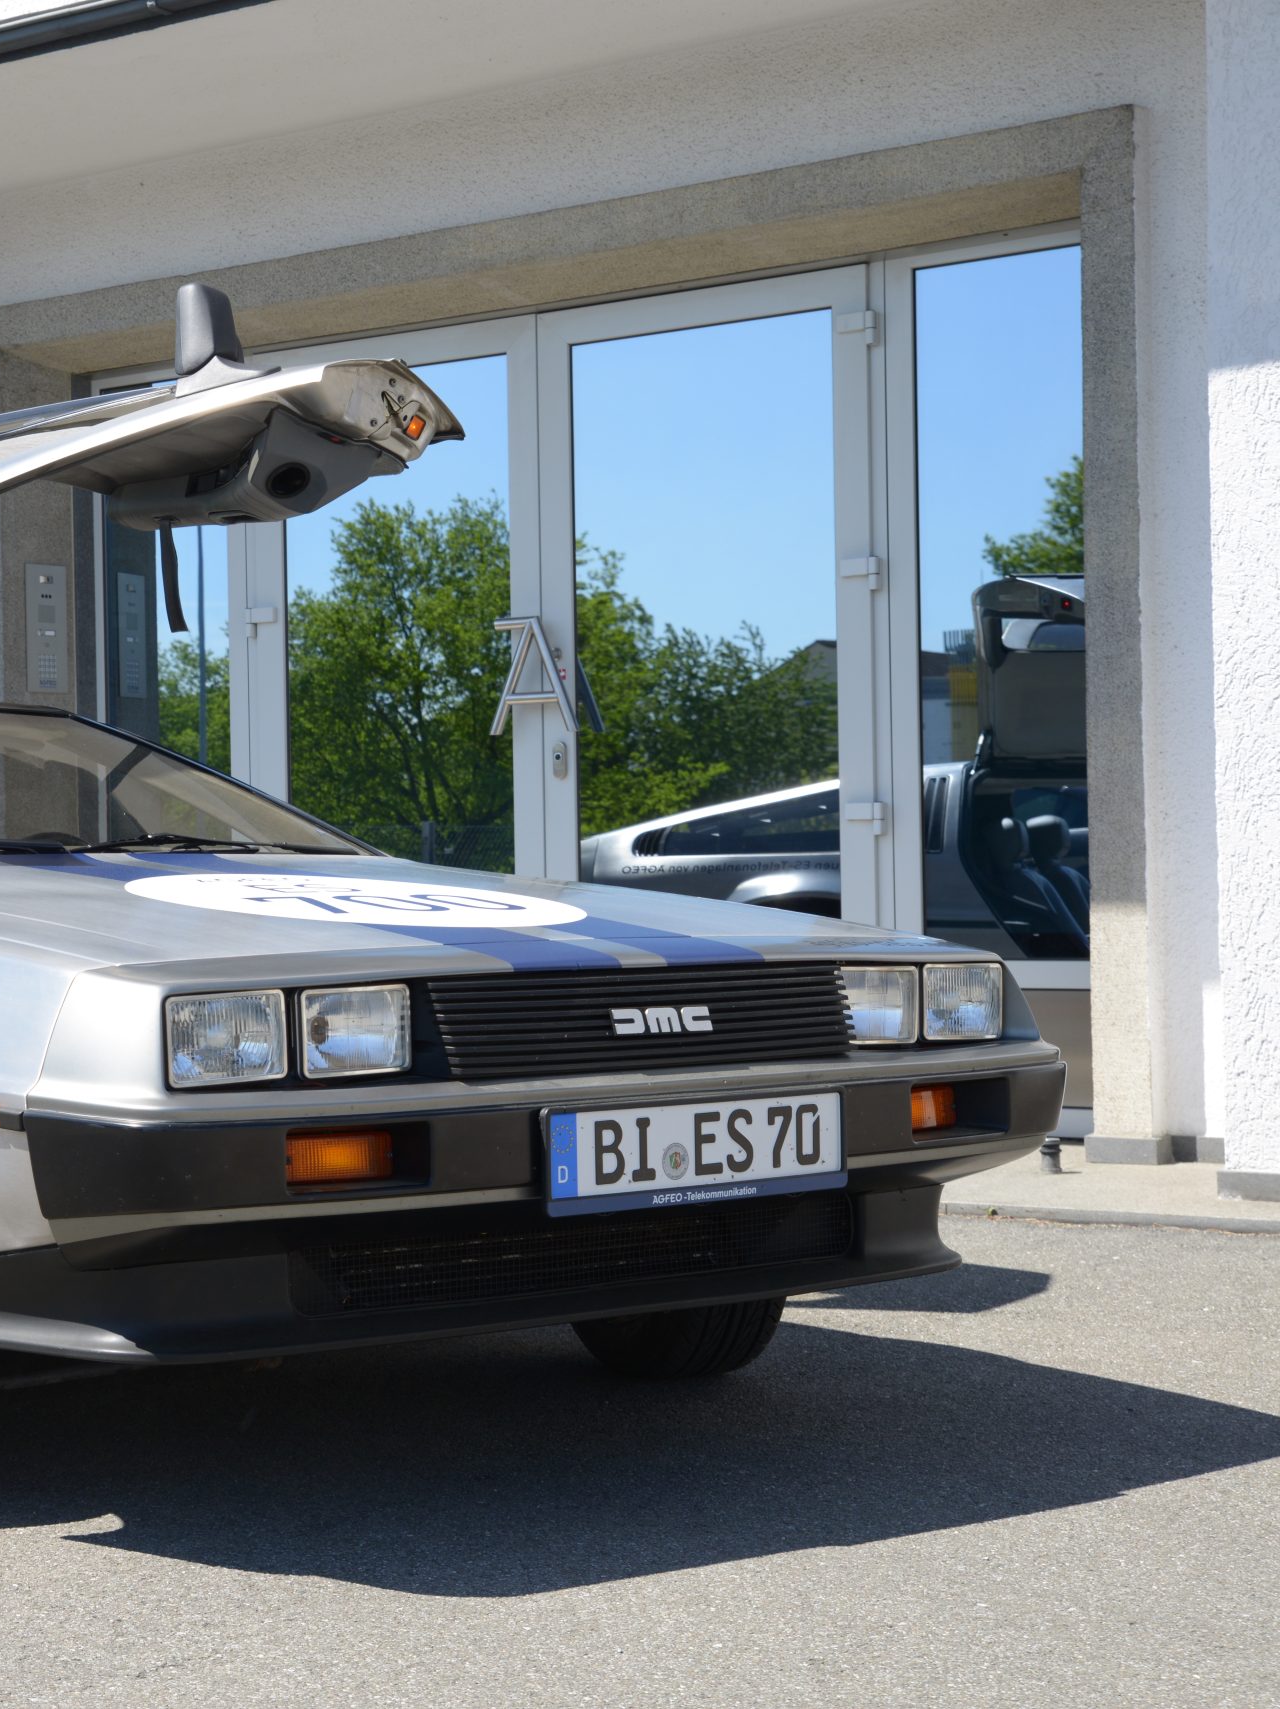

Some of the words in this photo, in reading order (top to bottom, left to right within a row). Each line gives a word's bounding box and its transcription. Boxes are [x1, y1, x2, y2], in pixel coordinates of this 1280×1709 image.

[243, 894, 527, 914] 700
[594, 1117, 656, 1185] BI
[557, 1165, 569, 1184] D
[652, 1194, 683, 1205] AGFEO
